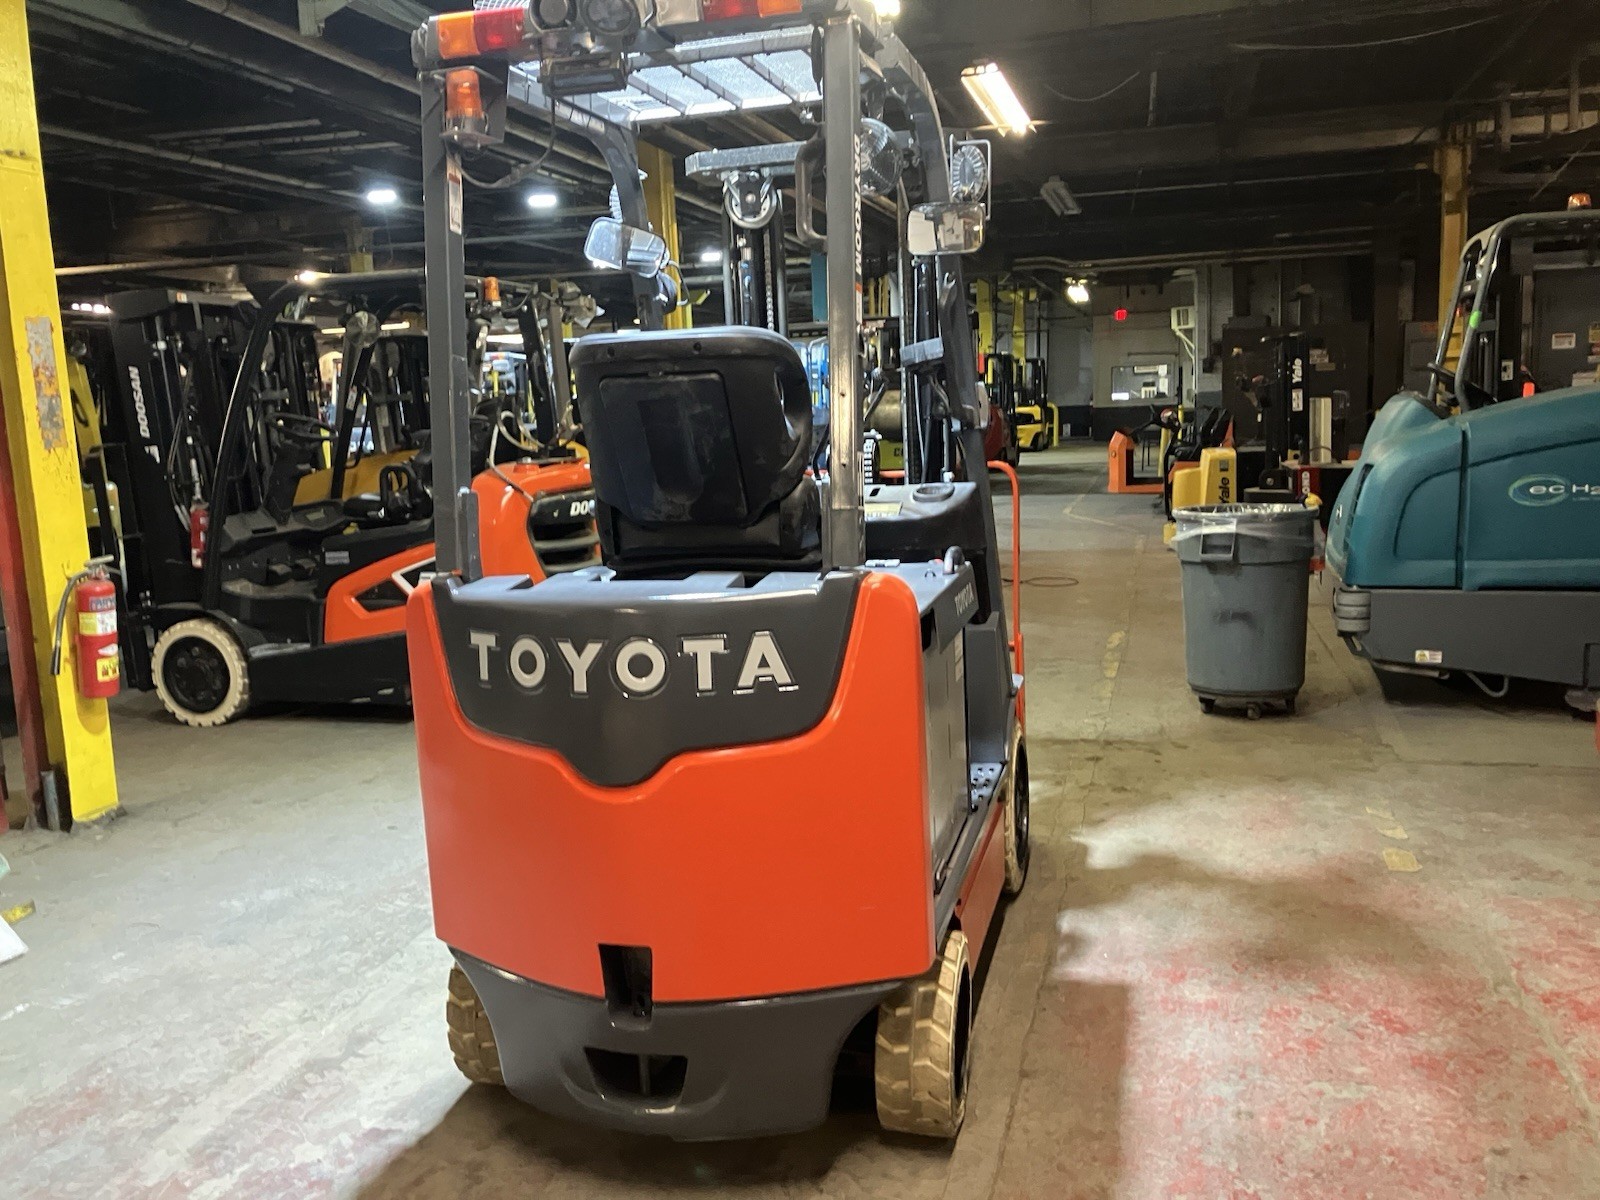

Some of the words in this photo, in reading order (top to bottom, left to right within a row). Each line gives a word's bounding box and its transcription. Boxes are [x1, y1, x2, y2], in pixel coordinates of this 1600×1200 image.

[128, 366, 150, 439] DOOSAN
[1292, 357, 1302, 384] Yale
[469, 630, 799, 698] TOYOTA
